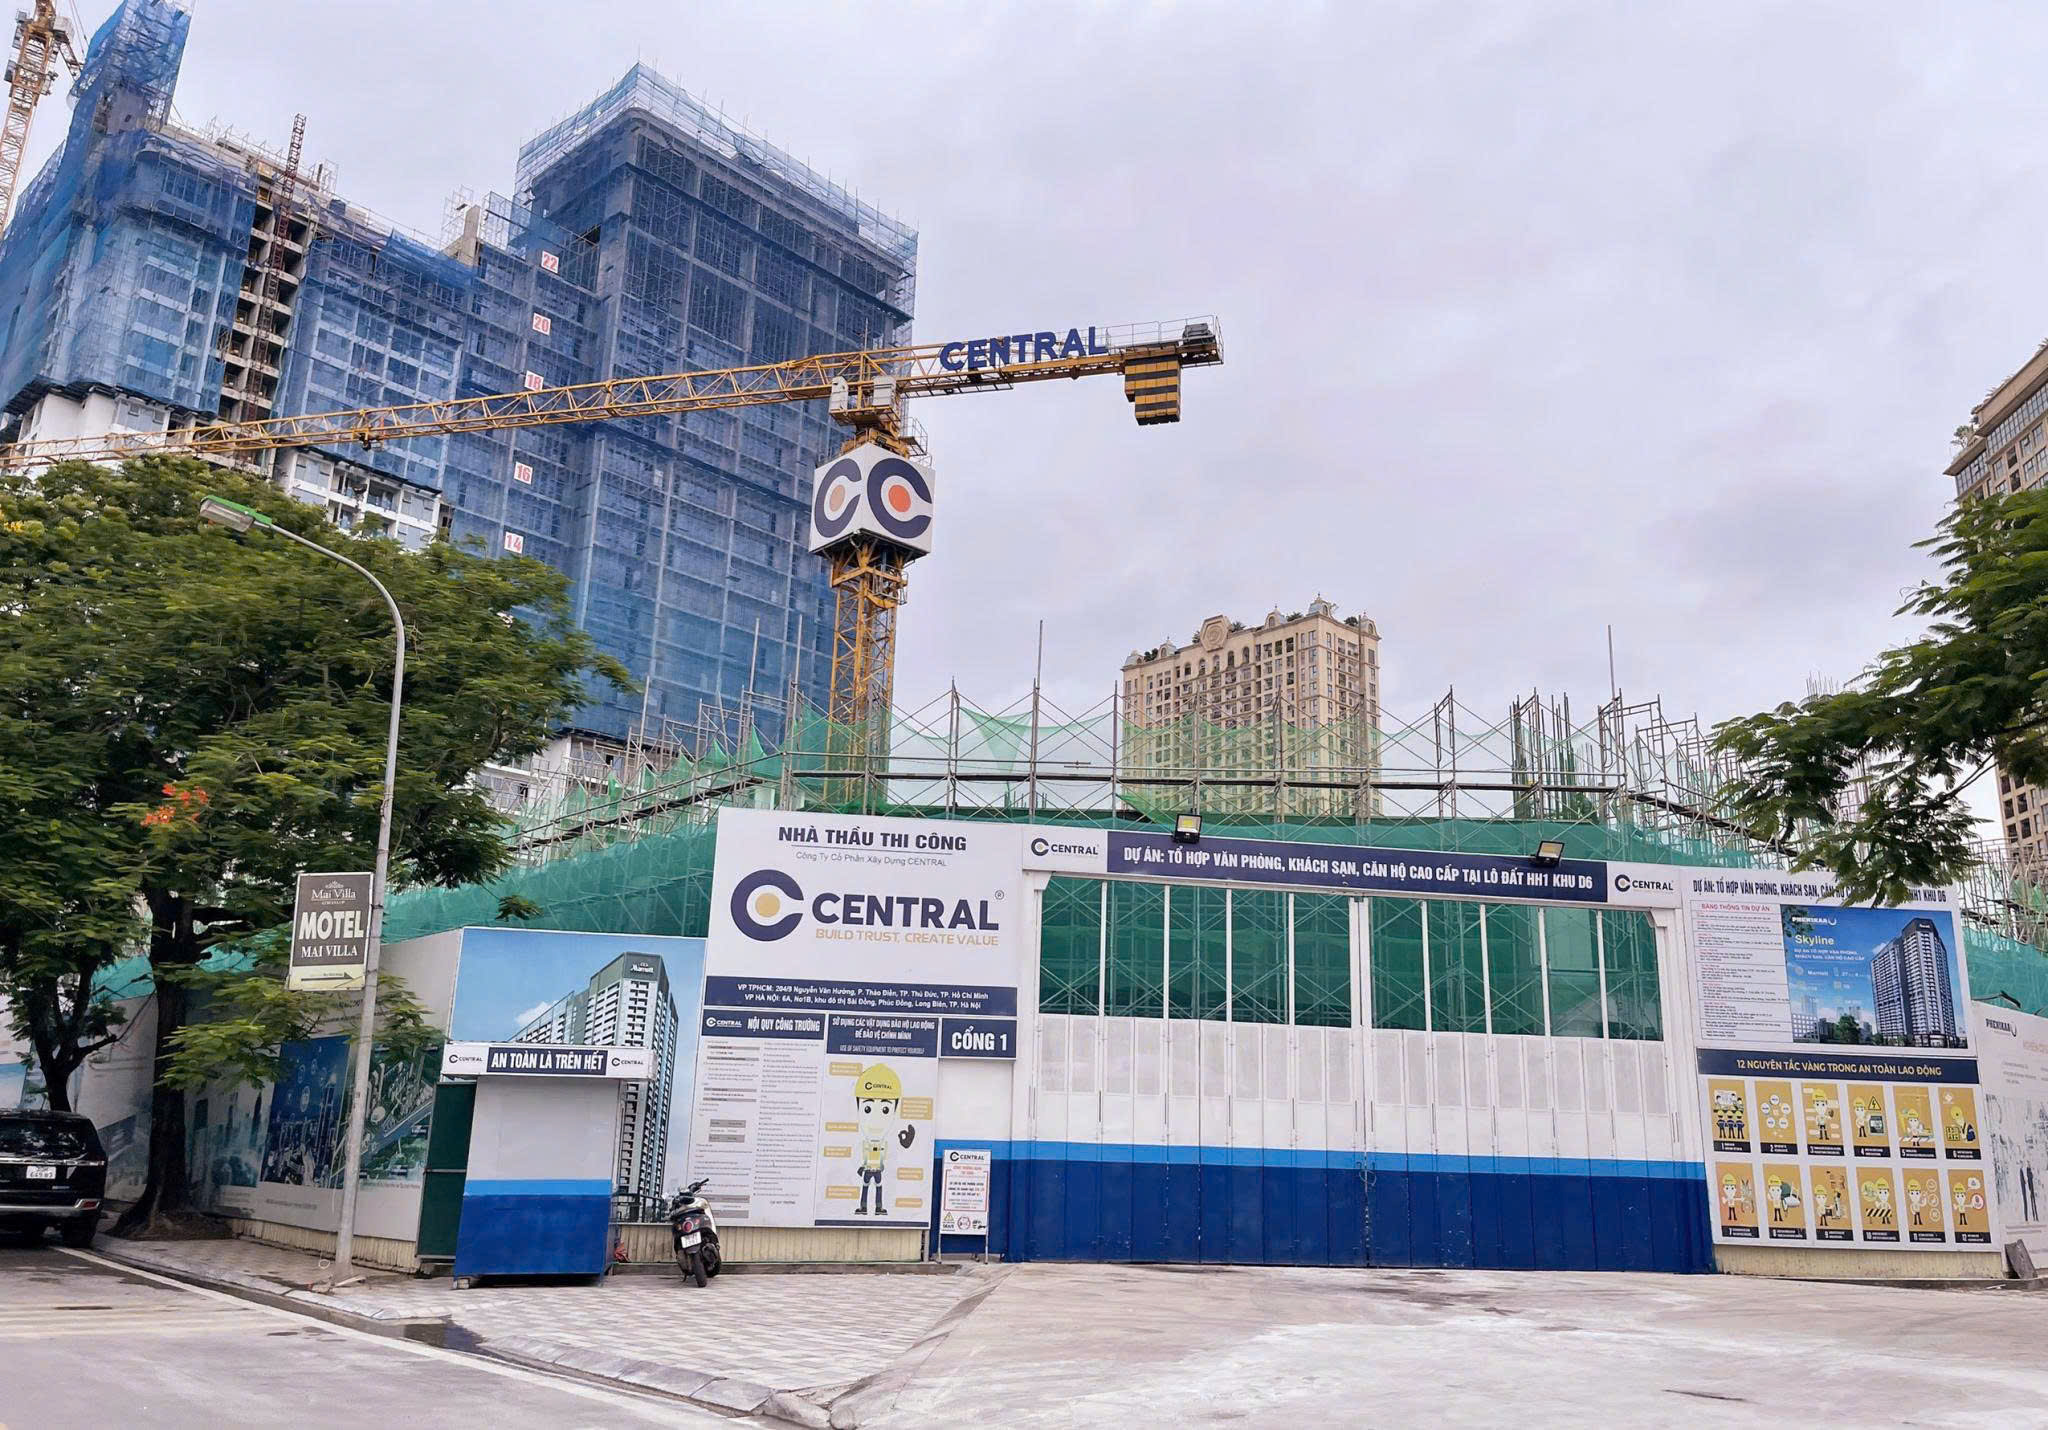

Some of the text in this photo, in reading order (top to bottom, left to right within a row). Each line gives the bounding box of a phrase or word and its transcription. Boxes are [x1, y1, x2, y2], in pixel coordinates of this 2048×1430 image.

[542, 254, 558, 271] 22
[533, 315, 550, 333] 20
[939, 325, 1110, 371] CENTRAL
[526, 373, 543, 390] 18
[515, 464, 532, 482] 16
[505, 534, 522, 552] 14
[778, 825, 967, 851] NHÀ THẦU THI CÔNG
[1051, 843, 1098, 855] CENTRAL
[796, 851, 817, 862] Công
[820, 853, 828, 862] Ty
[867, 855, 882, 865] Xây
[884, 856, 906, 867] Dựng
[908, 857, 948, 867] CENTRAL
[1124, 845, 1593, 890] DỰ ÁN: TỔ HỢP VĂN PHÒNG, KHÁCH SẠN, CĂN HỘ CAO CẤP TẠI LÔ ĐẤT HH1 KHU D6
[311, 888, 356, 899] Mai Villa
[1632, 879, 1674, 891] CENTRAL
[1693, 879, 1703, 896] DỰ
[1704, 879, 1715, 894] ÁN:
[1716, 876, 1724, 894] TỔ
[1725, 879, 1739, 897] HỢP
[1740, 879, 1754, 895] VĂN
[1780, 881, 1803, 897] KHÁCH
[1923, 887, 1937, 902] KHU
[812, 892, 999, 931] CENTRAL
[298, 910, 364, 940] MOTEL
[816, 928, 999, 946] BUILD TRUST, CREATE VALUE
[1794, 934, 1834, 947] Skyline
[301, 944, 358, 958] MAI VILLA
[748, 984, 773, 992] TPHCM:
[819, 986, 831, 994] Văn
[755, 993, 766, 1001] HÀ
[814, 996, 827, 1004] khu
[878, 998, 894, 1006] Phúc
[915, 1000, 931, 1009] Long
[970, 1001, 981, 1010] Nội
[747, 1016, 821, 1032] NỘI QUY CÔNG TRƯỜNG
[910, 1020, 920, 1029] LAO
[951, 1025, 1007, 1051] CỔNG 1
[491, 1049, 604, 1070] AN TOÀN LÀ TRÊN HẾT
[1736, 1059, 1942, 1077] 12 NGUYÊN TẮC VÀNG TRONG AN TOÀN LAO ĐỘNG
